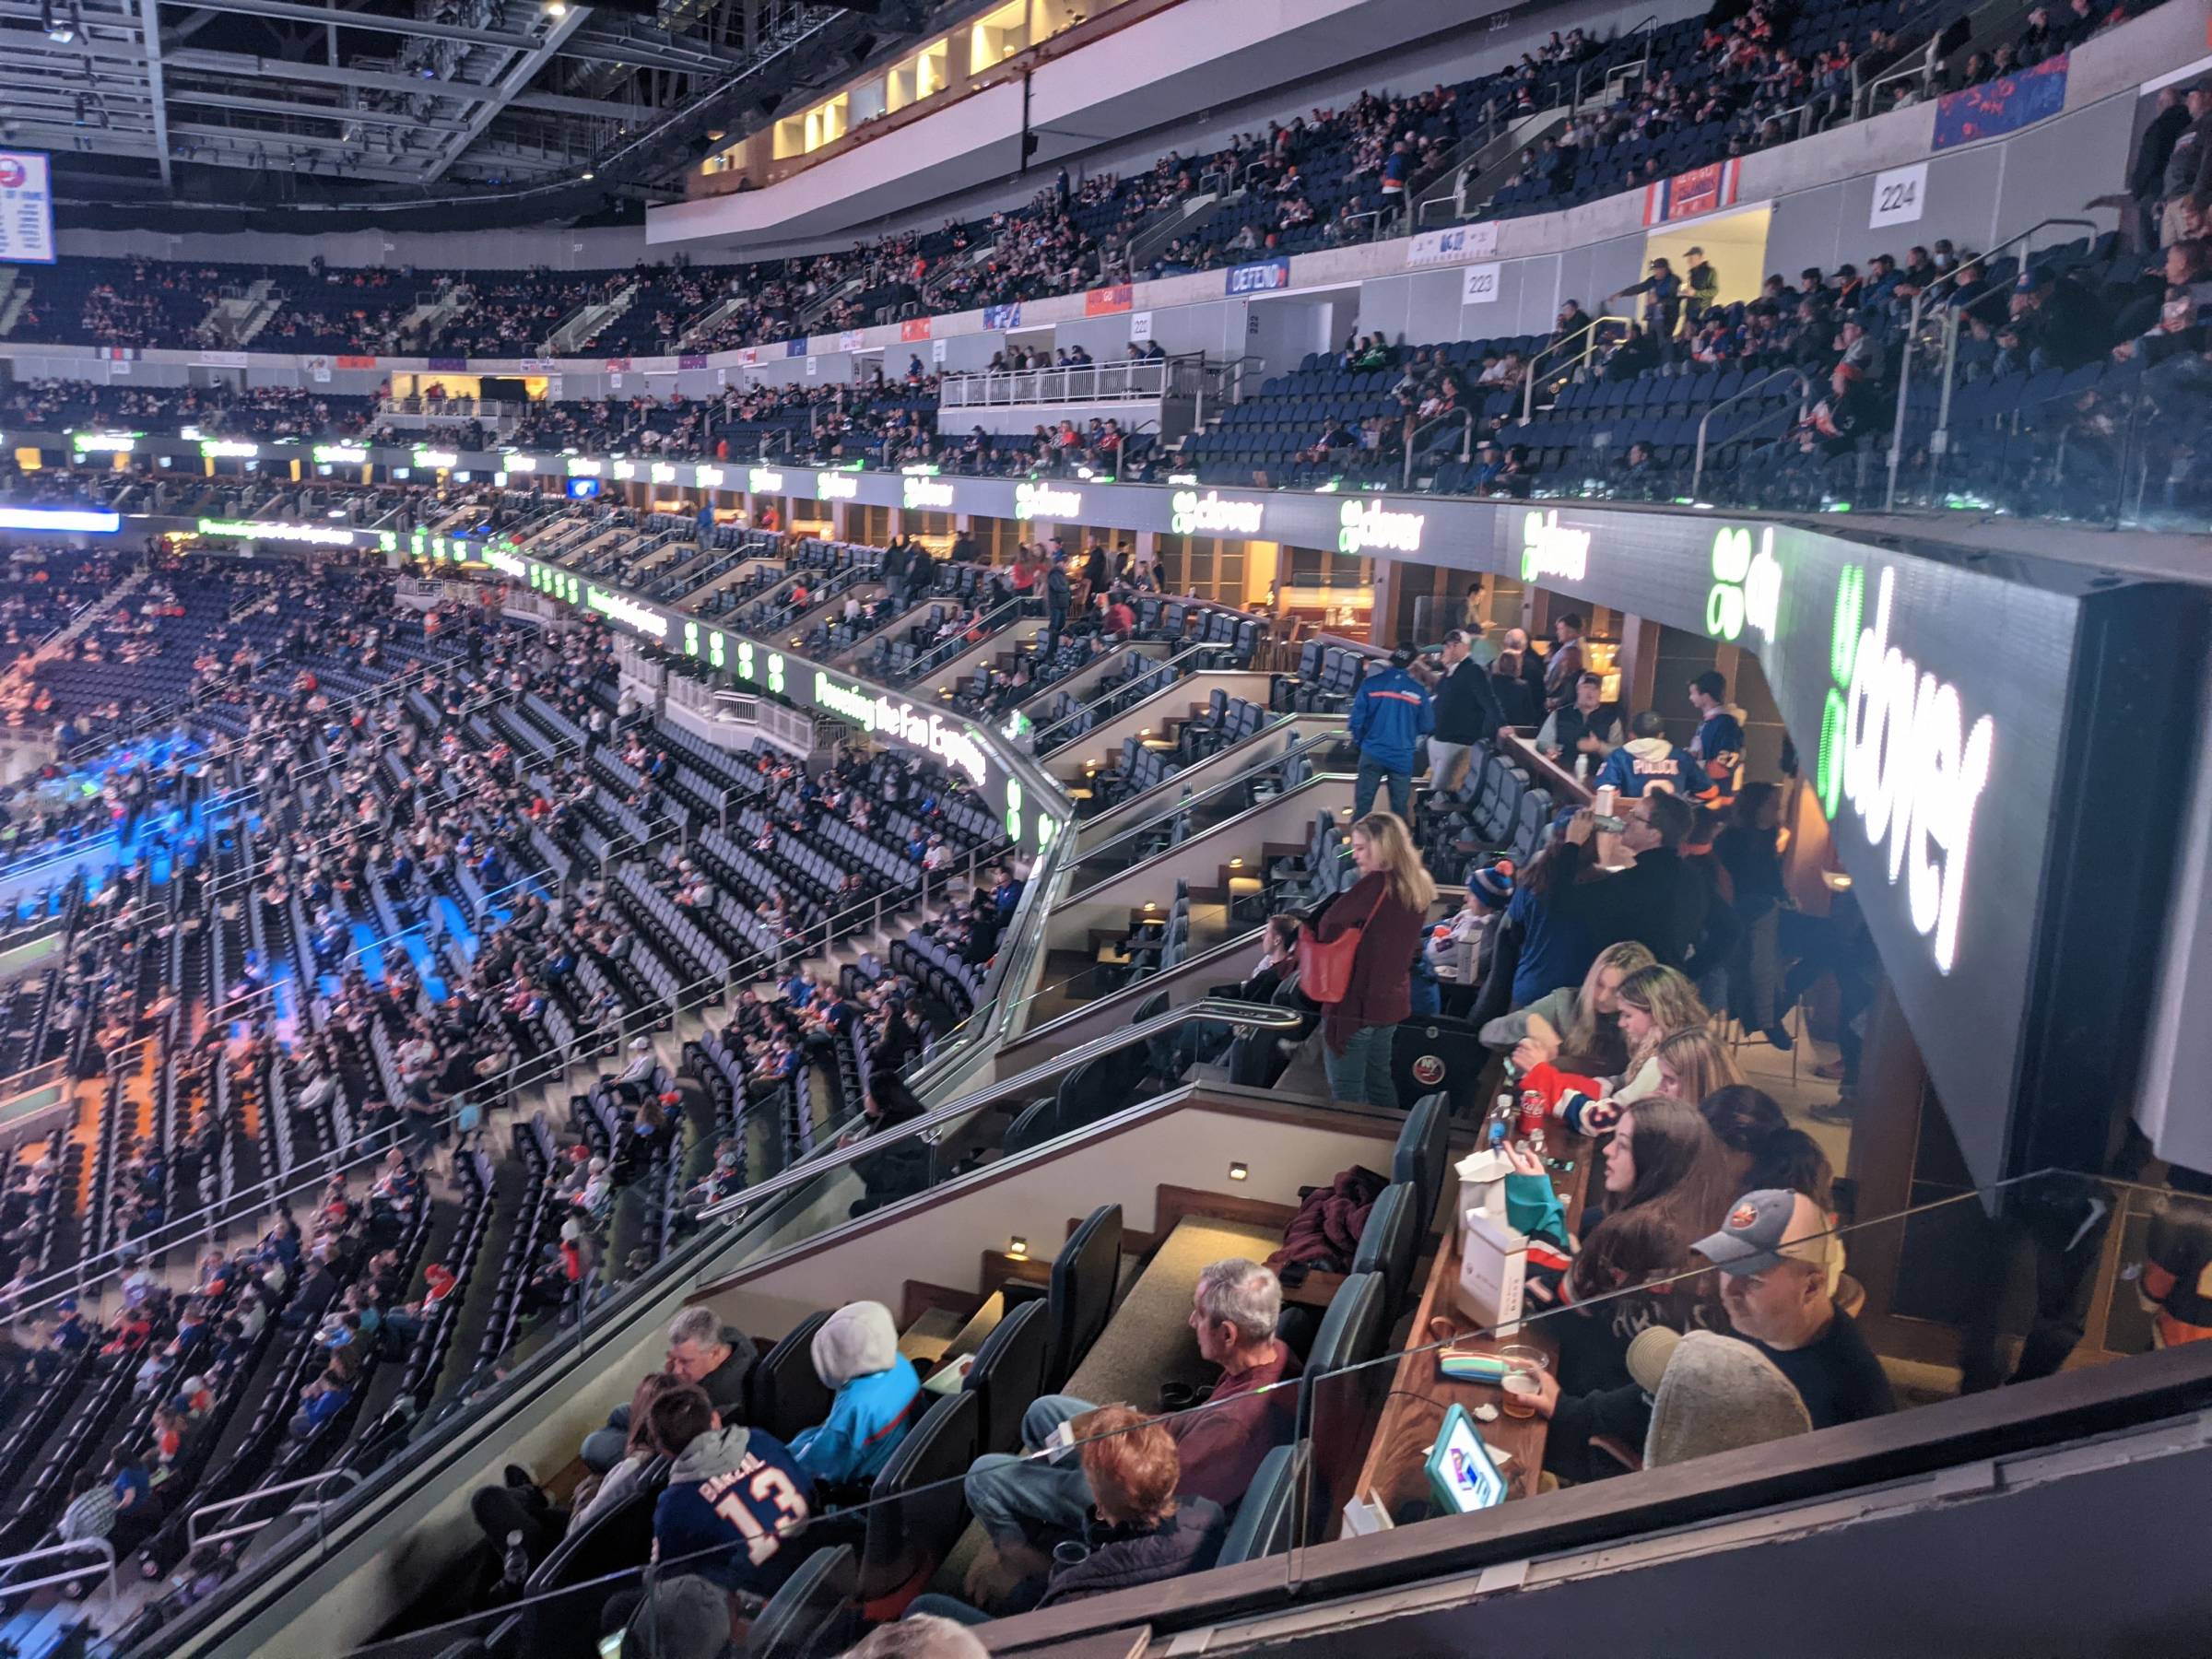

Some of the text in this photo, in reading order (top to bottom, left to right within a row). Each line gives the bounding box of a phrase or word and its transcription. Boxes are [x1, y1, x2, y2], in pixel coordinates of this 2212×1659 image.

[1879, 181, 1916, 212] 224
[1231, 264, 1279, 292] DEFEND
[1468, 273, 1493, 294] 223
[1249, 315, 1260, 335] 222
[1194, 491, 1264, 533] clover
[1359, 500, 1425, 551] clover
[1717, 749, 1740, 769] 27
[1844, 565, 1994, 976] clover
[714, 1466, 809, 1568] 13
